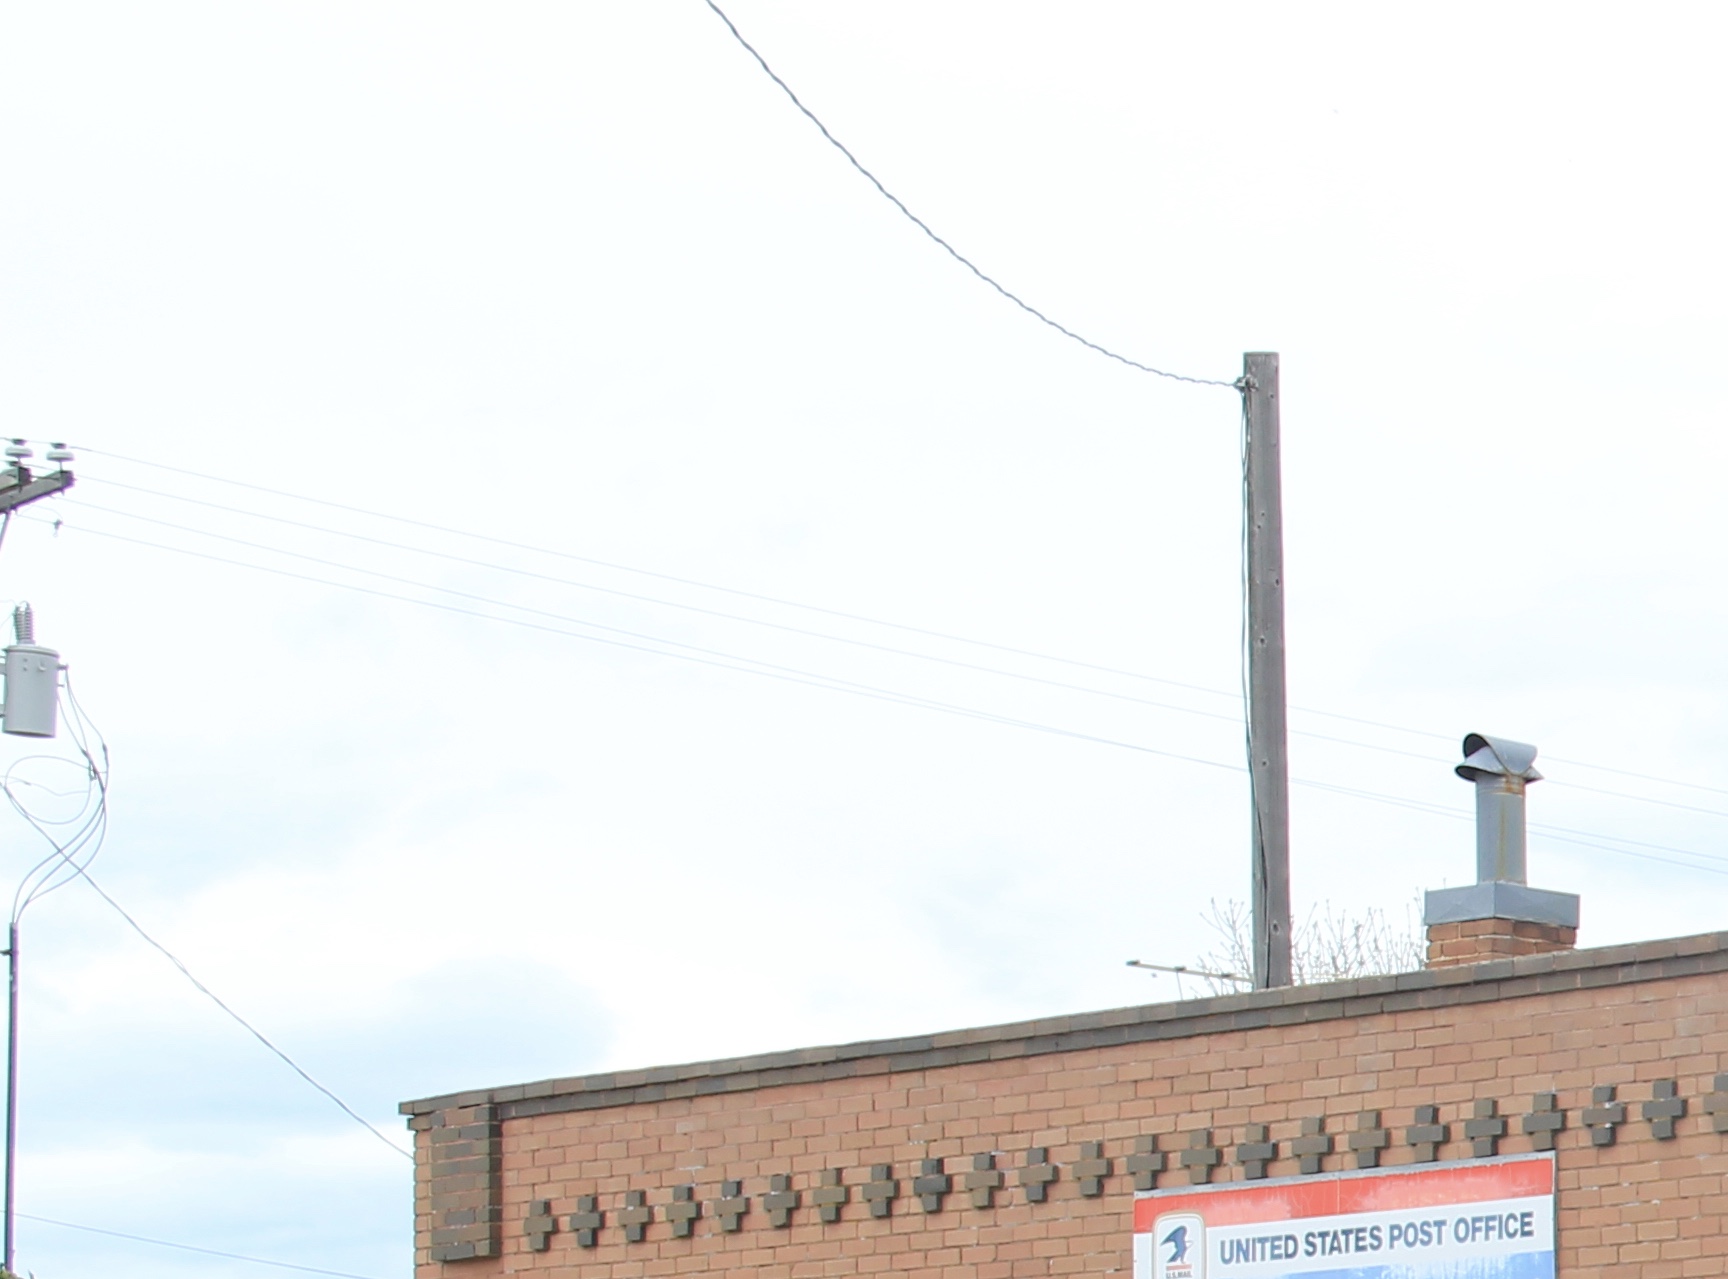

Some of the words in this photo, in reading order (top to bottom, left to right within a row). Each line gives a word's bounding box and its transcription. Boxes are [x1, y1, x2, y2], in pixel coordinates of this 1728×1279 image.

[1220, 1234, 1299, 1265] UNITED
[1304, 1225, 1383, 1257] STATES
[1389, 1219, 1447, 1250] POST
[1454, 1211, 1534, 1243] OFFICE
